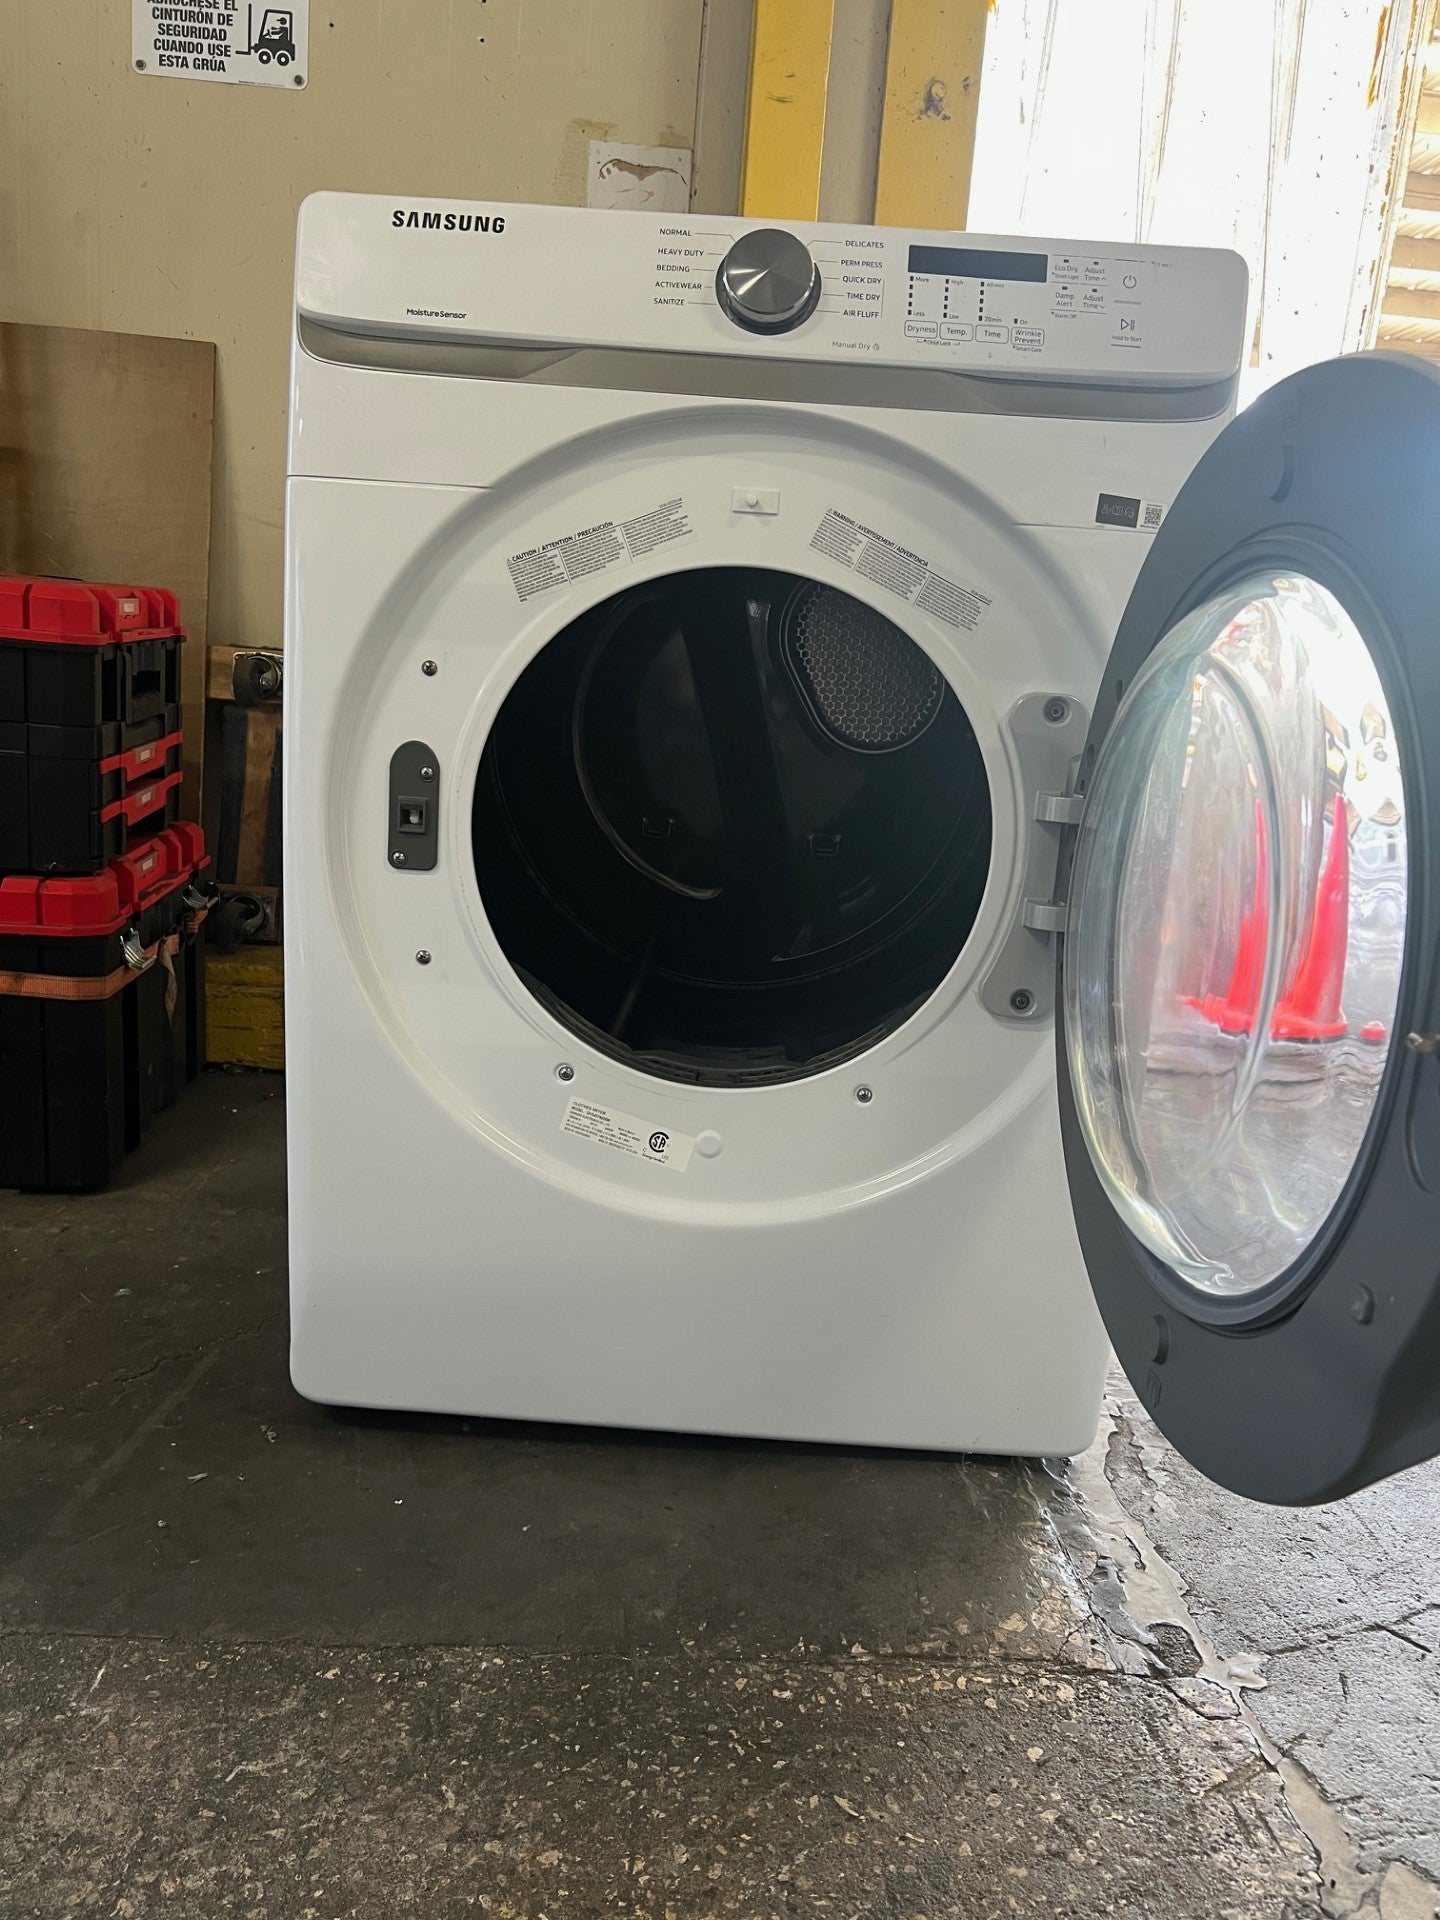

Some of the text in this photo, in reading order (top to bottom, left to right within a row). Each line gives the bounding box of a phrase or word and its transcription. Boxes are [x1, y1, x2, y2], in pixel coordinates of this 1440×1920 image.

[152, 7, 233, 26] CINTURÓN DE
[158, 23, 227, 41] SEGURIDAD
[154, 39, 231, 57] CUANDO USE
[158, 54, 226, 72] ESTA GRÚA
[392, 210, 505, 233] SAMSUNG
[659, 228, 692, 236] NORMAL
[845, 240, 884, 249] DELICATES
[840, 259, 860, 267] PERM
[656, 264, 690, 272] BEDDING
[1067, 265, 1078, 273] Dry
[1085, 267, 1105, 275] Adjust
[842, 275, 865, 284] QUICK
[655, 281, 702, 290] ACTIVEWEAR
[847, 292, 863, 300] TIME
[1055, 292, 1075, 300] Damp
[1083, 294, 1104, 302] Adjust
[653, 298, 685, 306] SANITIZE
[857, 310, 879, 318] FLUFF
[907, 325, 936, 334] Dryness
[947, 327, 968, 336] Temp.
[983, 330, 1001, 338] Time
[1015, 329, 1042, 337] Wrinkle
[832, 341, 870, 351] Manual Dry
[833, 510, 856, 527] WARNING
[512, 549, 537, 562] CAUTION
[541, 536, 573, 551] ATTENTION
